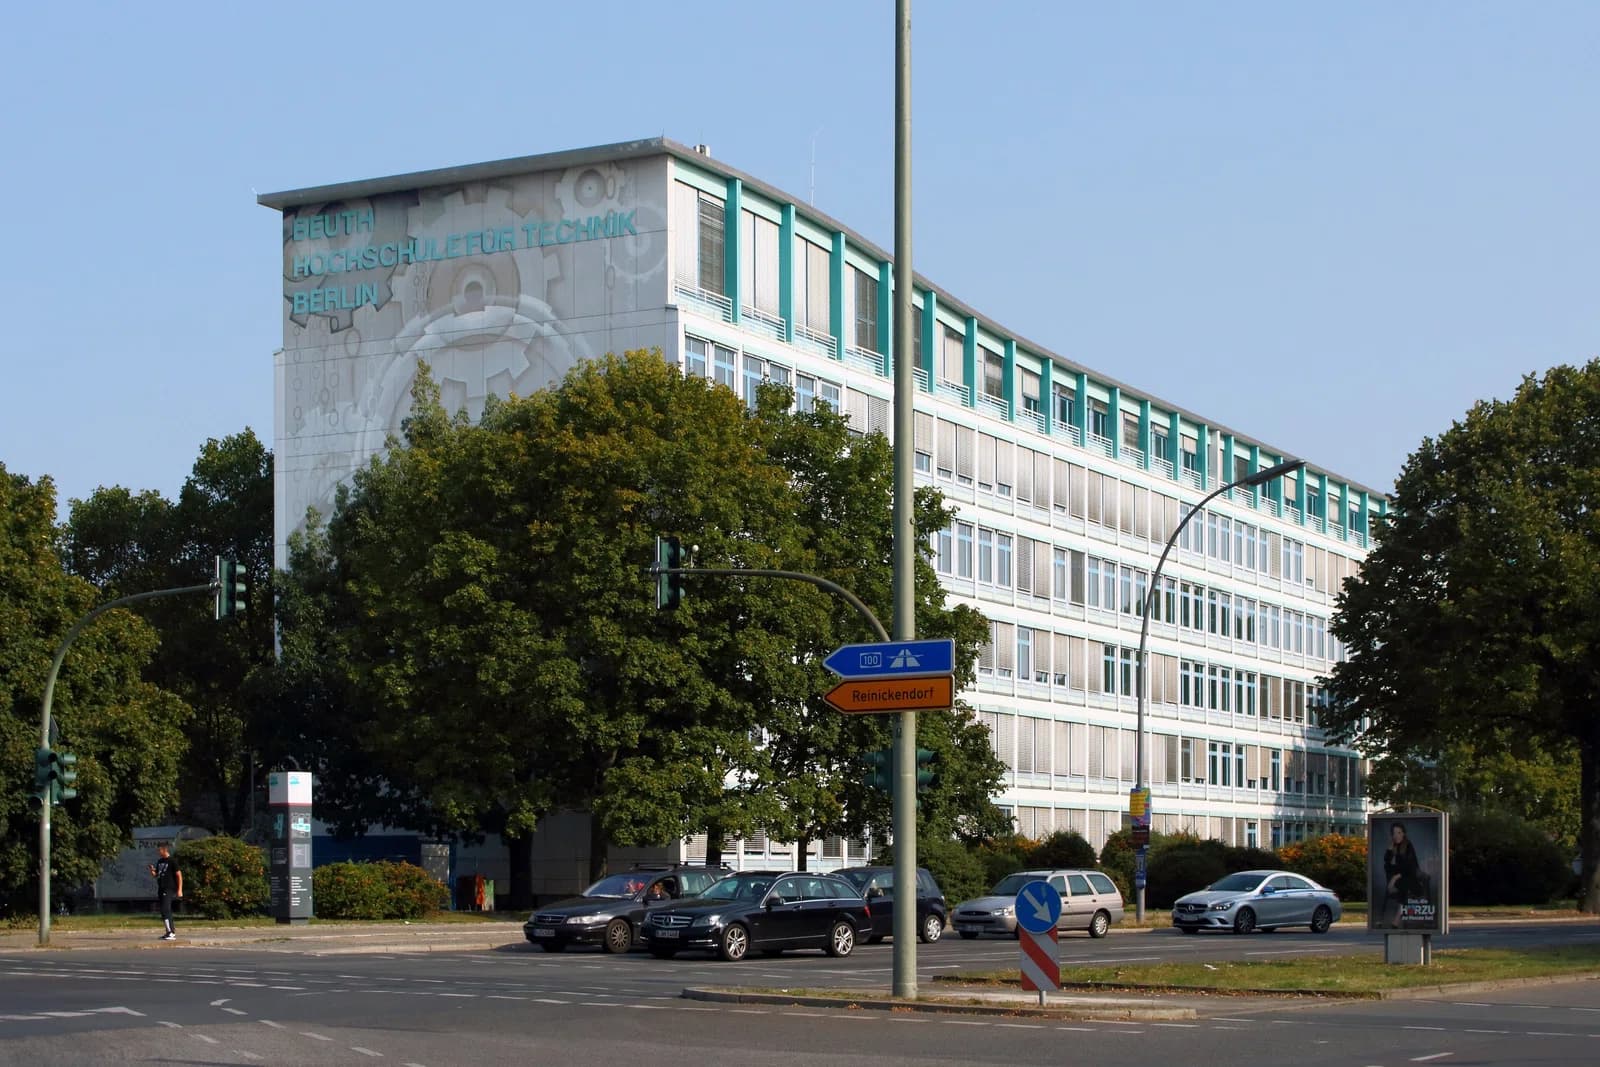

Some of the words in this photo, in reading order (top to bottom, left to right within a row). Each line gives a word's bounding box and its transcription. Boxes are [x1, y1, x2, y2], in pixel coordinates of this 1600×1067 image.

[294, 208, 373, 240] BEUTH
[293, 232, 464, 278] HOCHSCHULE
[521, 208, 638, 248] TECHNIK
[293, 282, 379, 315] BERLIN
[864, 655, 878, 665] 100
[852, 687, 934, 702] Reinickendorf
